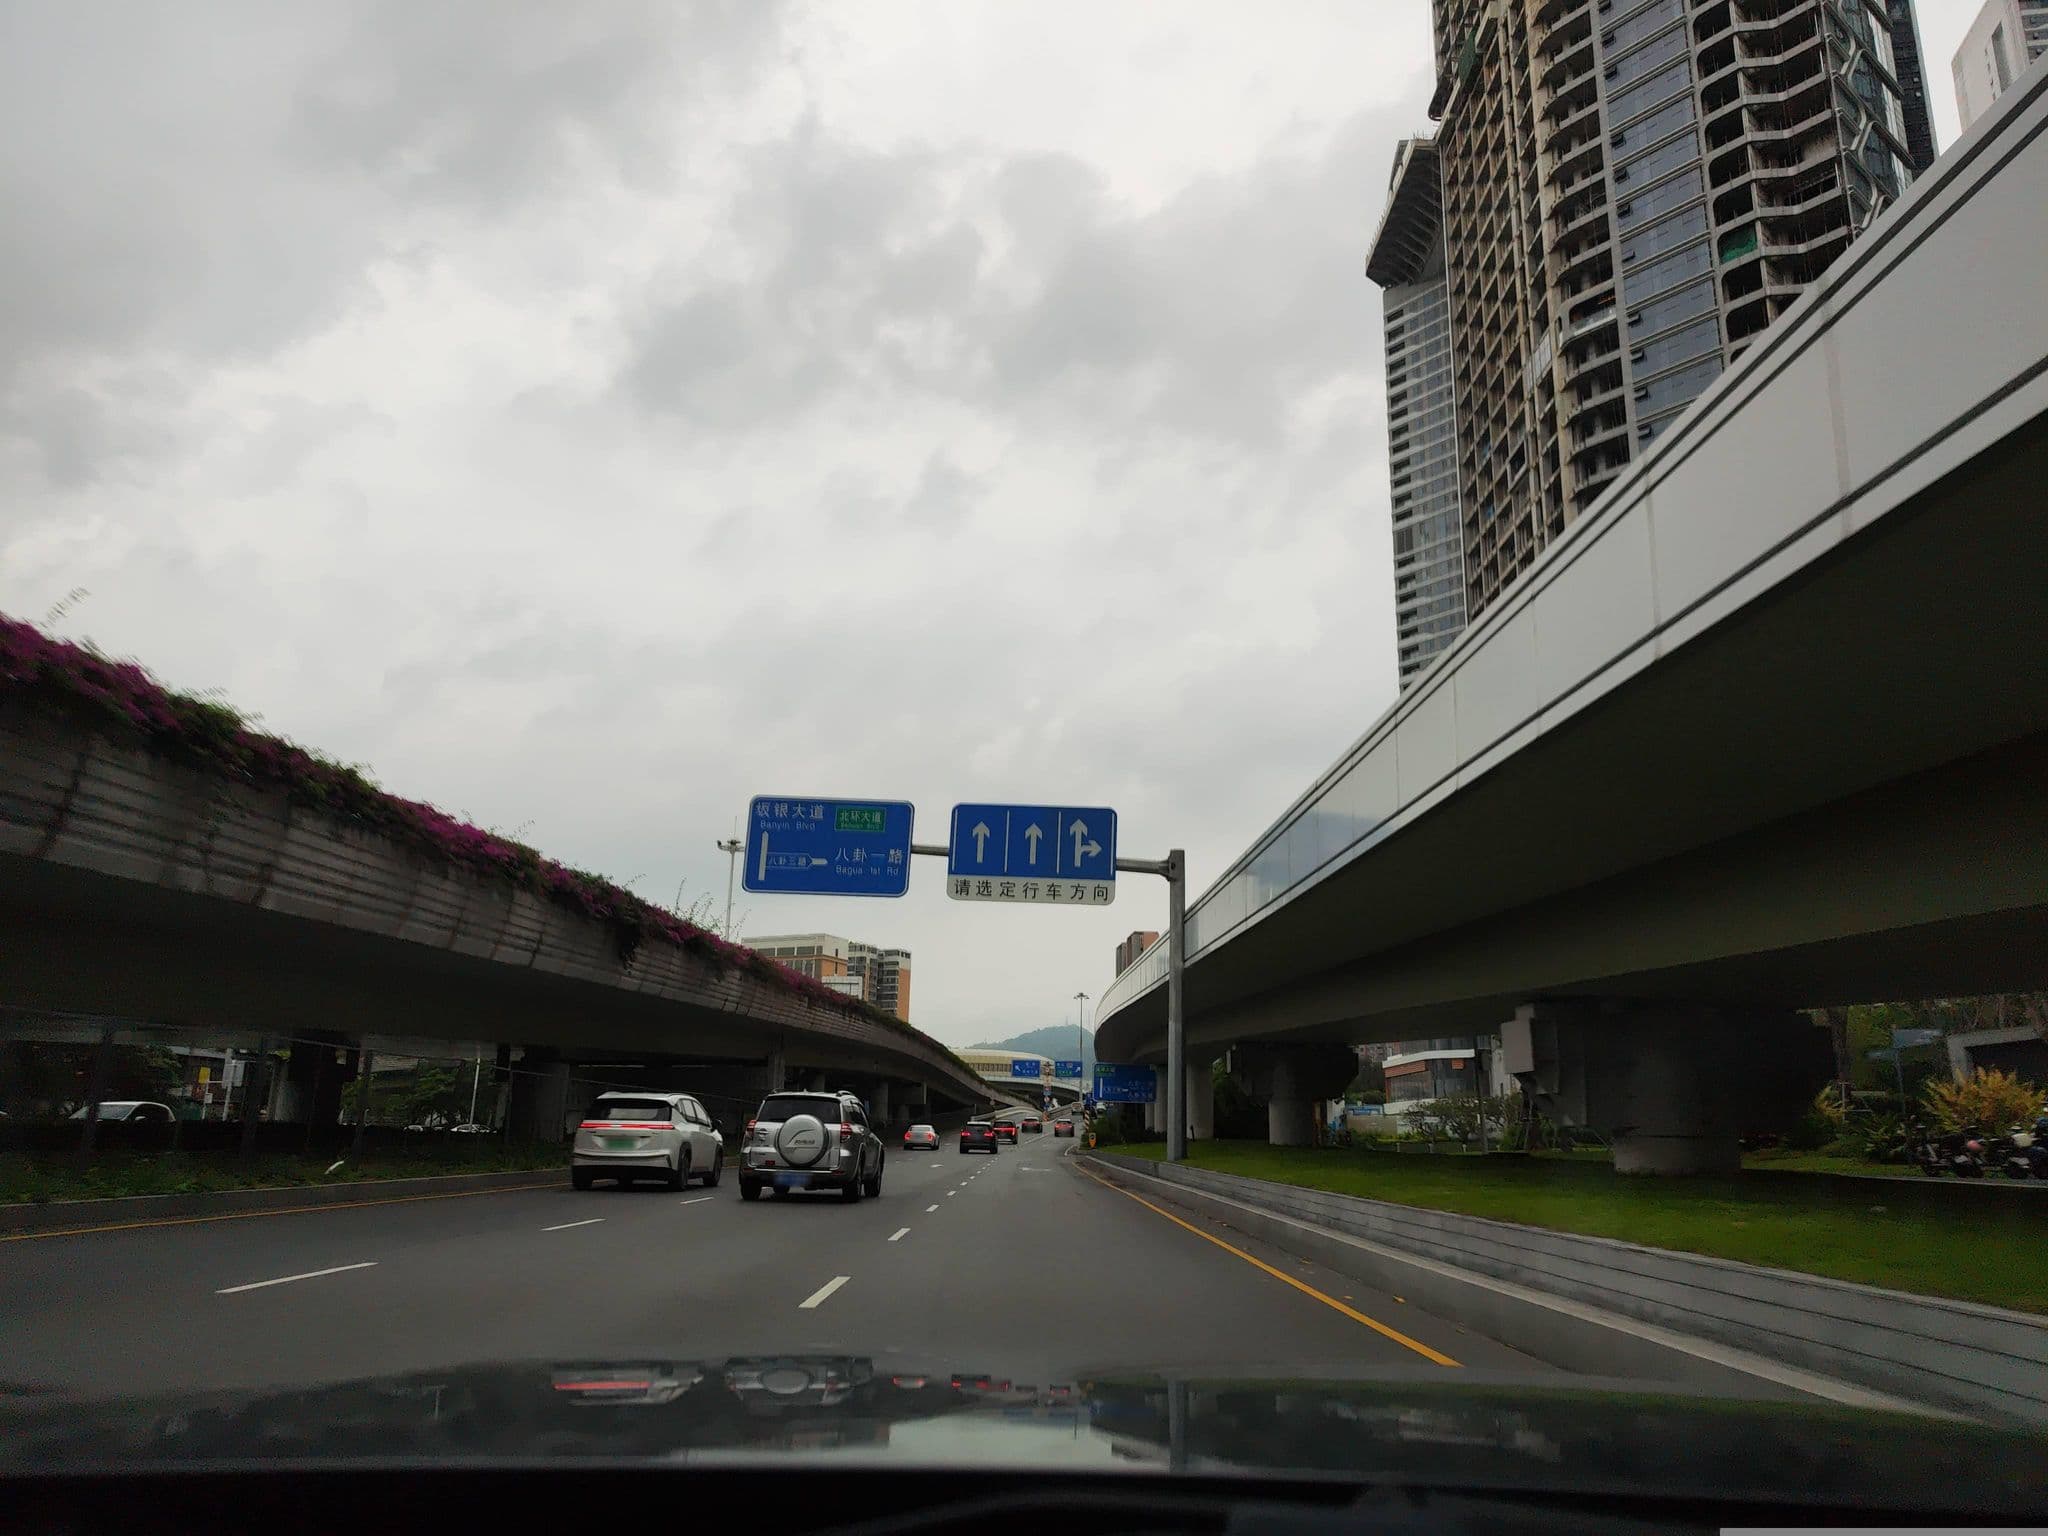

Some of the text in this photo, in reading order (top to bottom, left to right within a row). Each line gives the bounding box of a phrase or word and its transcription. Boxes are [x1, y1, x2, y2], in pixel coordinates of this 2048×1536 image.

[755, 802, 825, 820] 板银大道
[840, 809, 882, 824] 北环大道
[760, 820, 816, 831] Banyin Blvd
[834, 847, 904, 865] 八卦一路
[835, 866, 863, 876] Bagua
[887, 867, 899, 876] Rd
[954, 878, 1109, 902] 请选定行车方向
